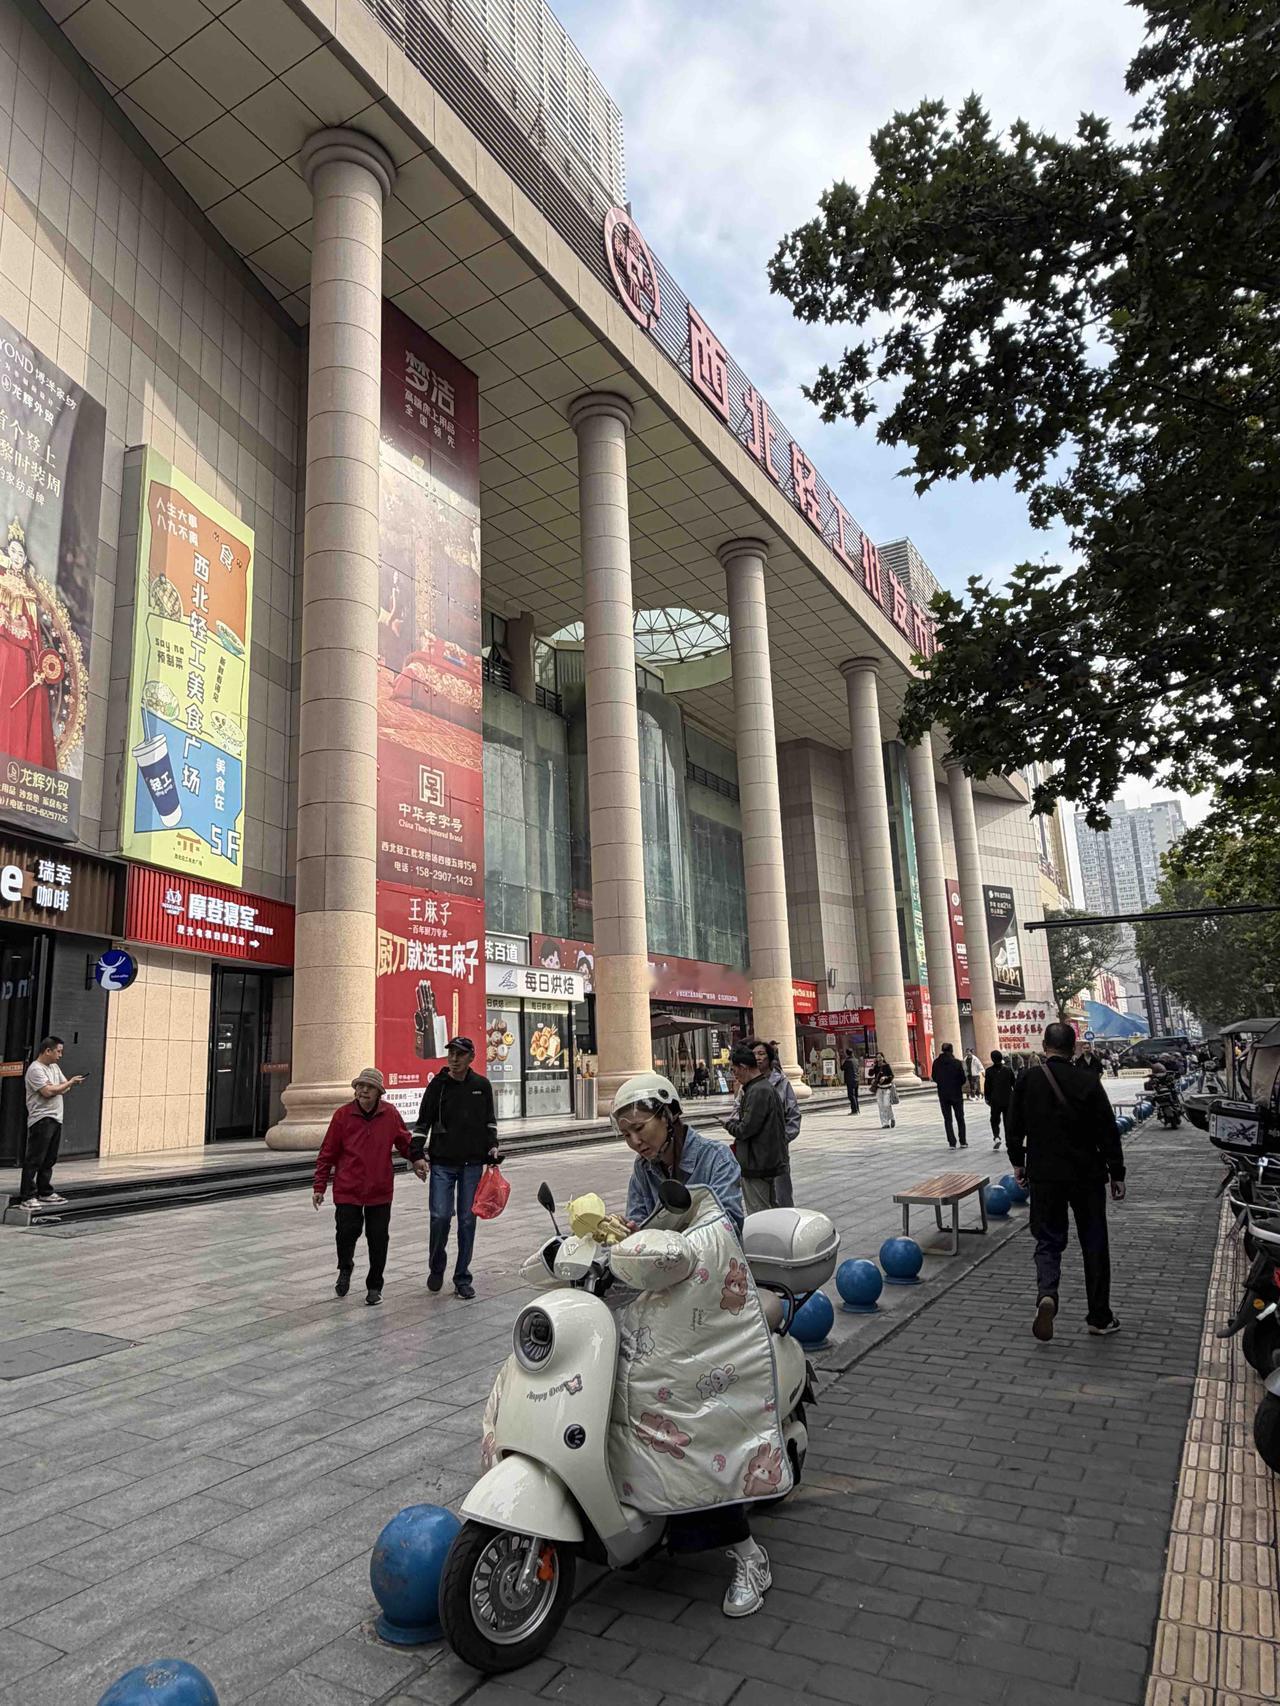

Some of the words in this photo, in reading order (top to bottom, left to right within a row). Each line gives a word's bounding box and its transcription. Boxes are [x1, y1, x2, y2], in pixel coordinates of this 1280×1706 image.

[35, 368, 77, 410] 博洋家纺
[405, 349, 455, 417] 梦洁
[12, 383, 55, 426] 龙辉外贸
[219, 543, 235, 572] 食
[155, 637, 171, 653] say
[174, 644, 184, 655] no
[157, 650, 184, 670] 预制菜
[181, 550, 210, 797] 西北轻工美食广场
[20, 767, 70, 799] 龙辉外贸
[149, 771, 172, 792] 轻工
[214, 757, 227, 811] 美食在
[398, 803, 463, 833] 中华老字号
[398, 818, 414, 830] China
[449, 832, 463, 843] Brand
[210, 823, 241, 866] 5F
[0, 863, 24, 902] e
[37, 858, 72, 887] 瑞幸
[36, 884, 70, 912] 咖啡
[188, 893, 255, 931] 摩登寝室
[408, 897, 452, 926] 王麻子
[376, 927, 479, 985] 厨刀就选王麻子
[485, 939, 518, 963] 茶百道
[525, 971, 574, 996] 每日烘焙
[997, 966, 1022, 988] TOP1
